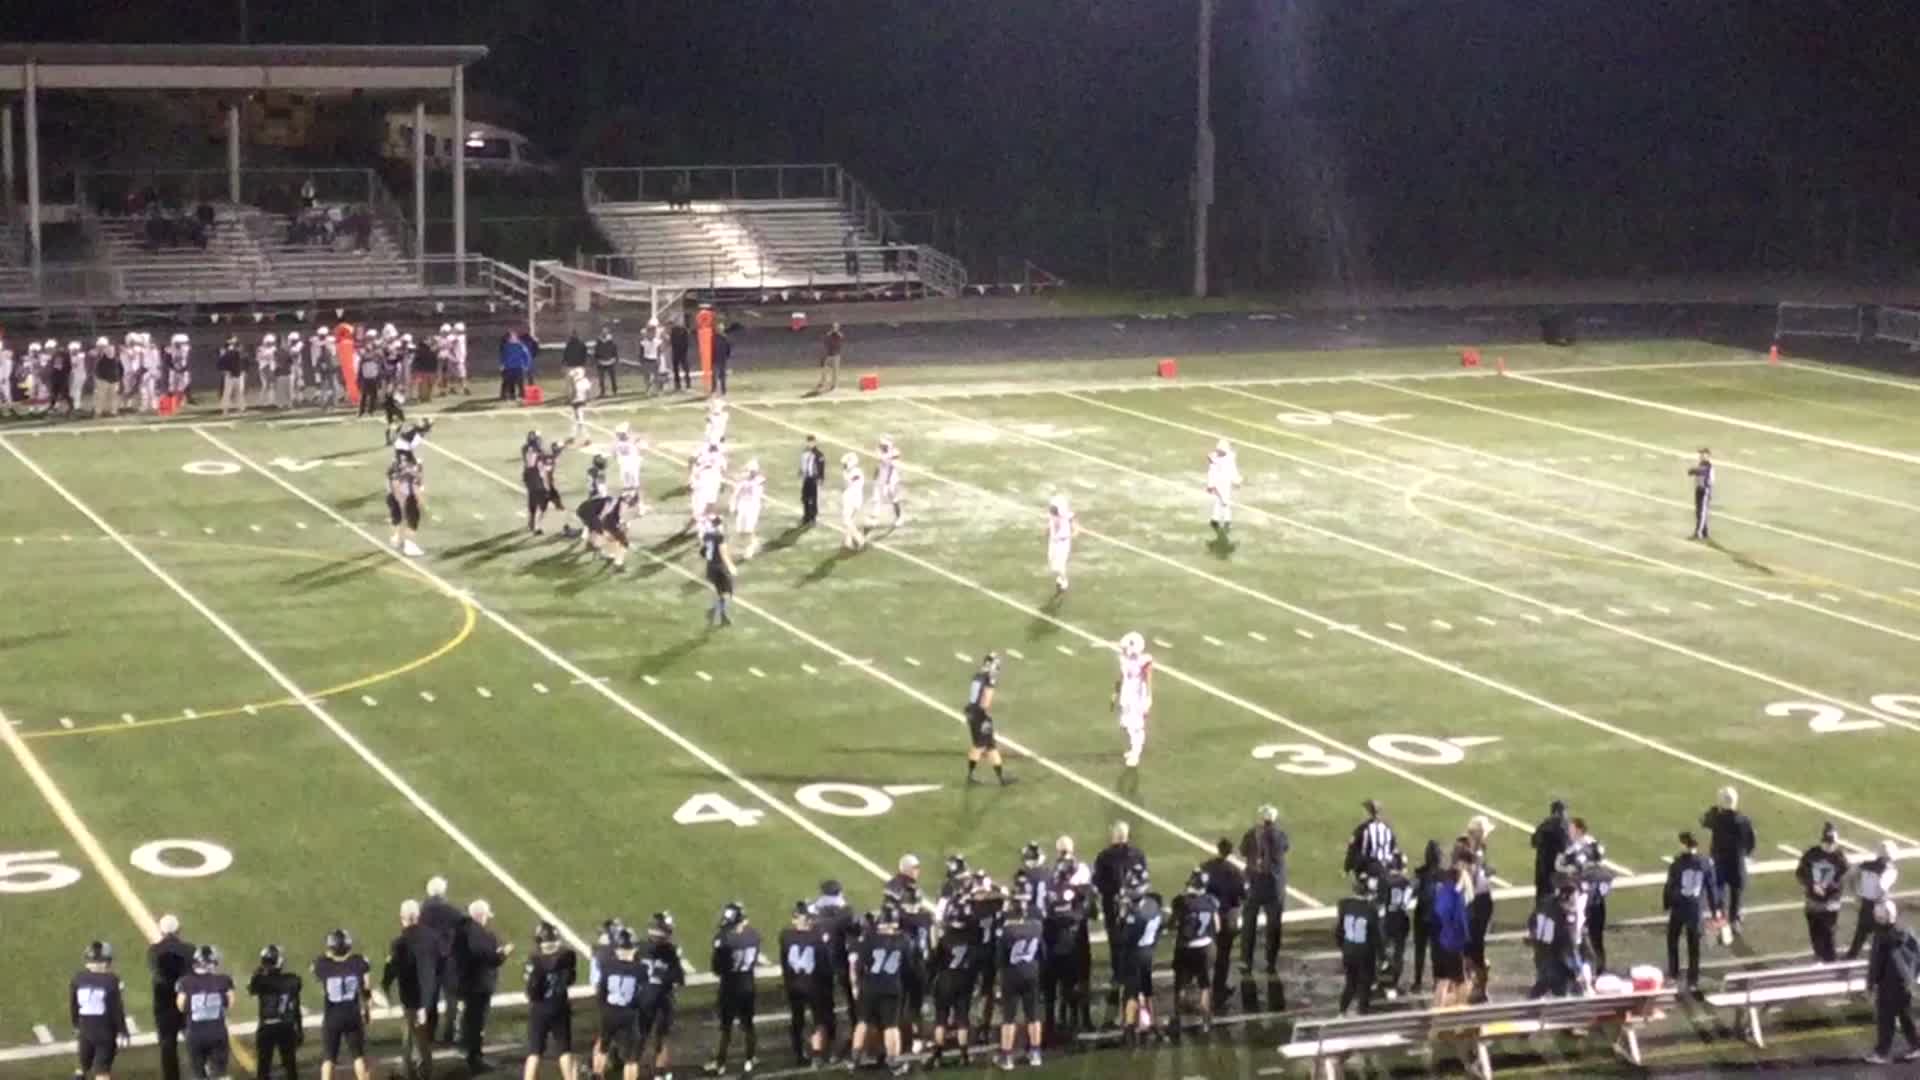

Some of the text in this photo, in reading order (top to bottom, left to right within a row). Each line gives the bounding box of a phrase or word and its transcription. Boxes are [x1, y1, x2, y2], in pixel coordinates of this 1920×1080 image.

[1251, 733, 1465, 776] 30
[672, 782, 894, 825] 40
[0, 838, 233, 893] 50
